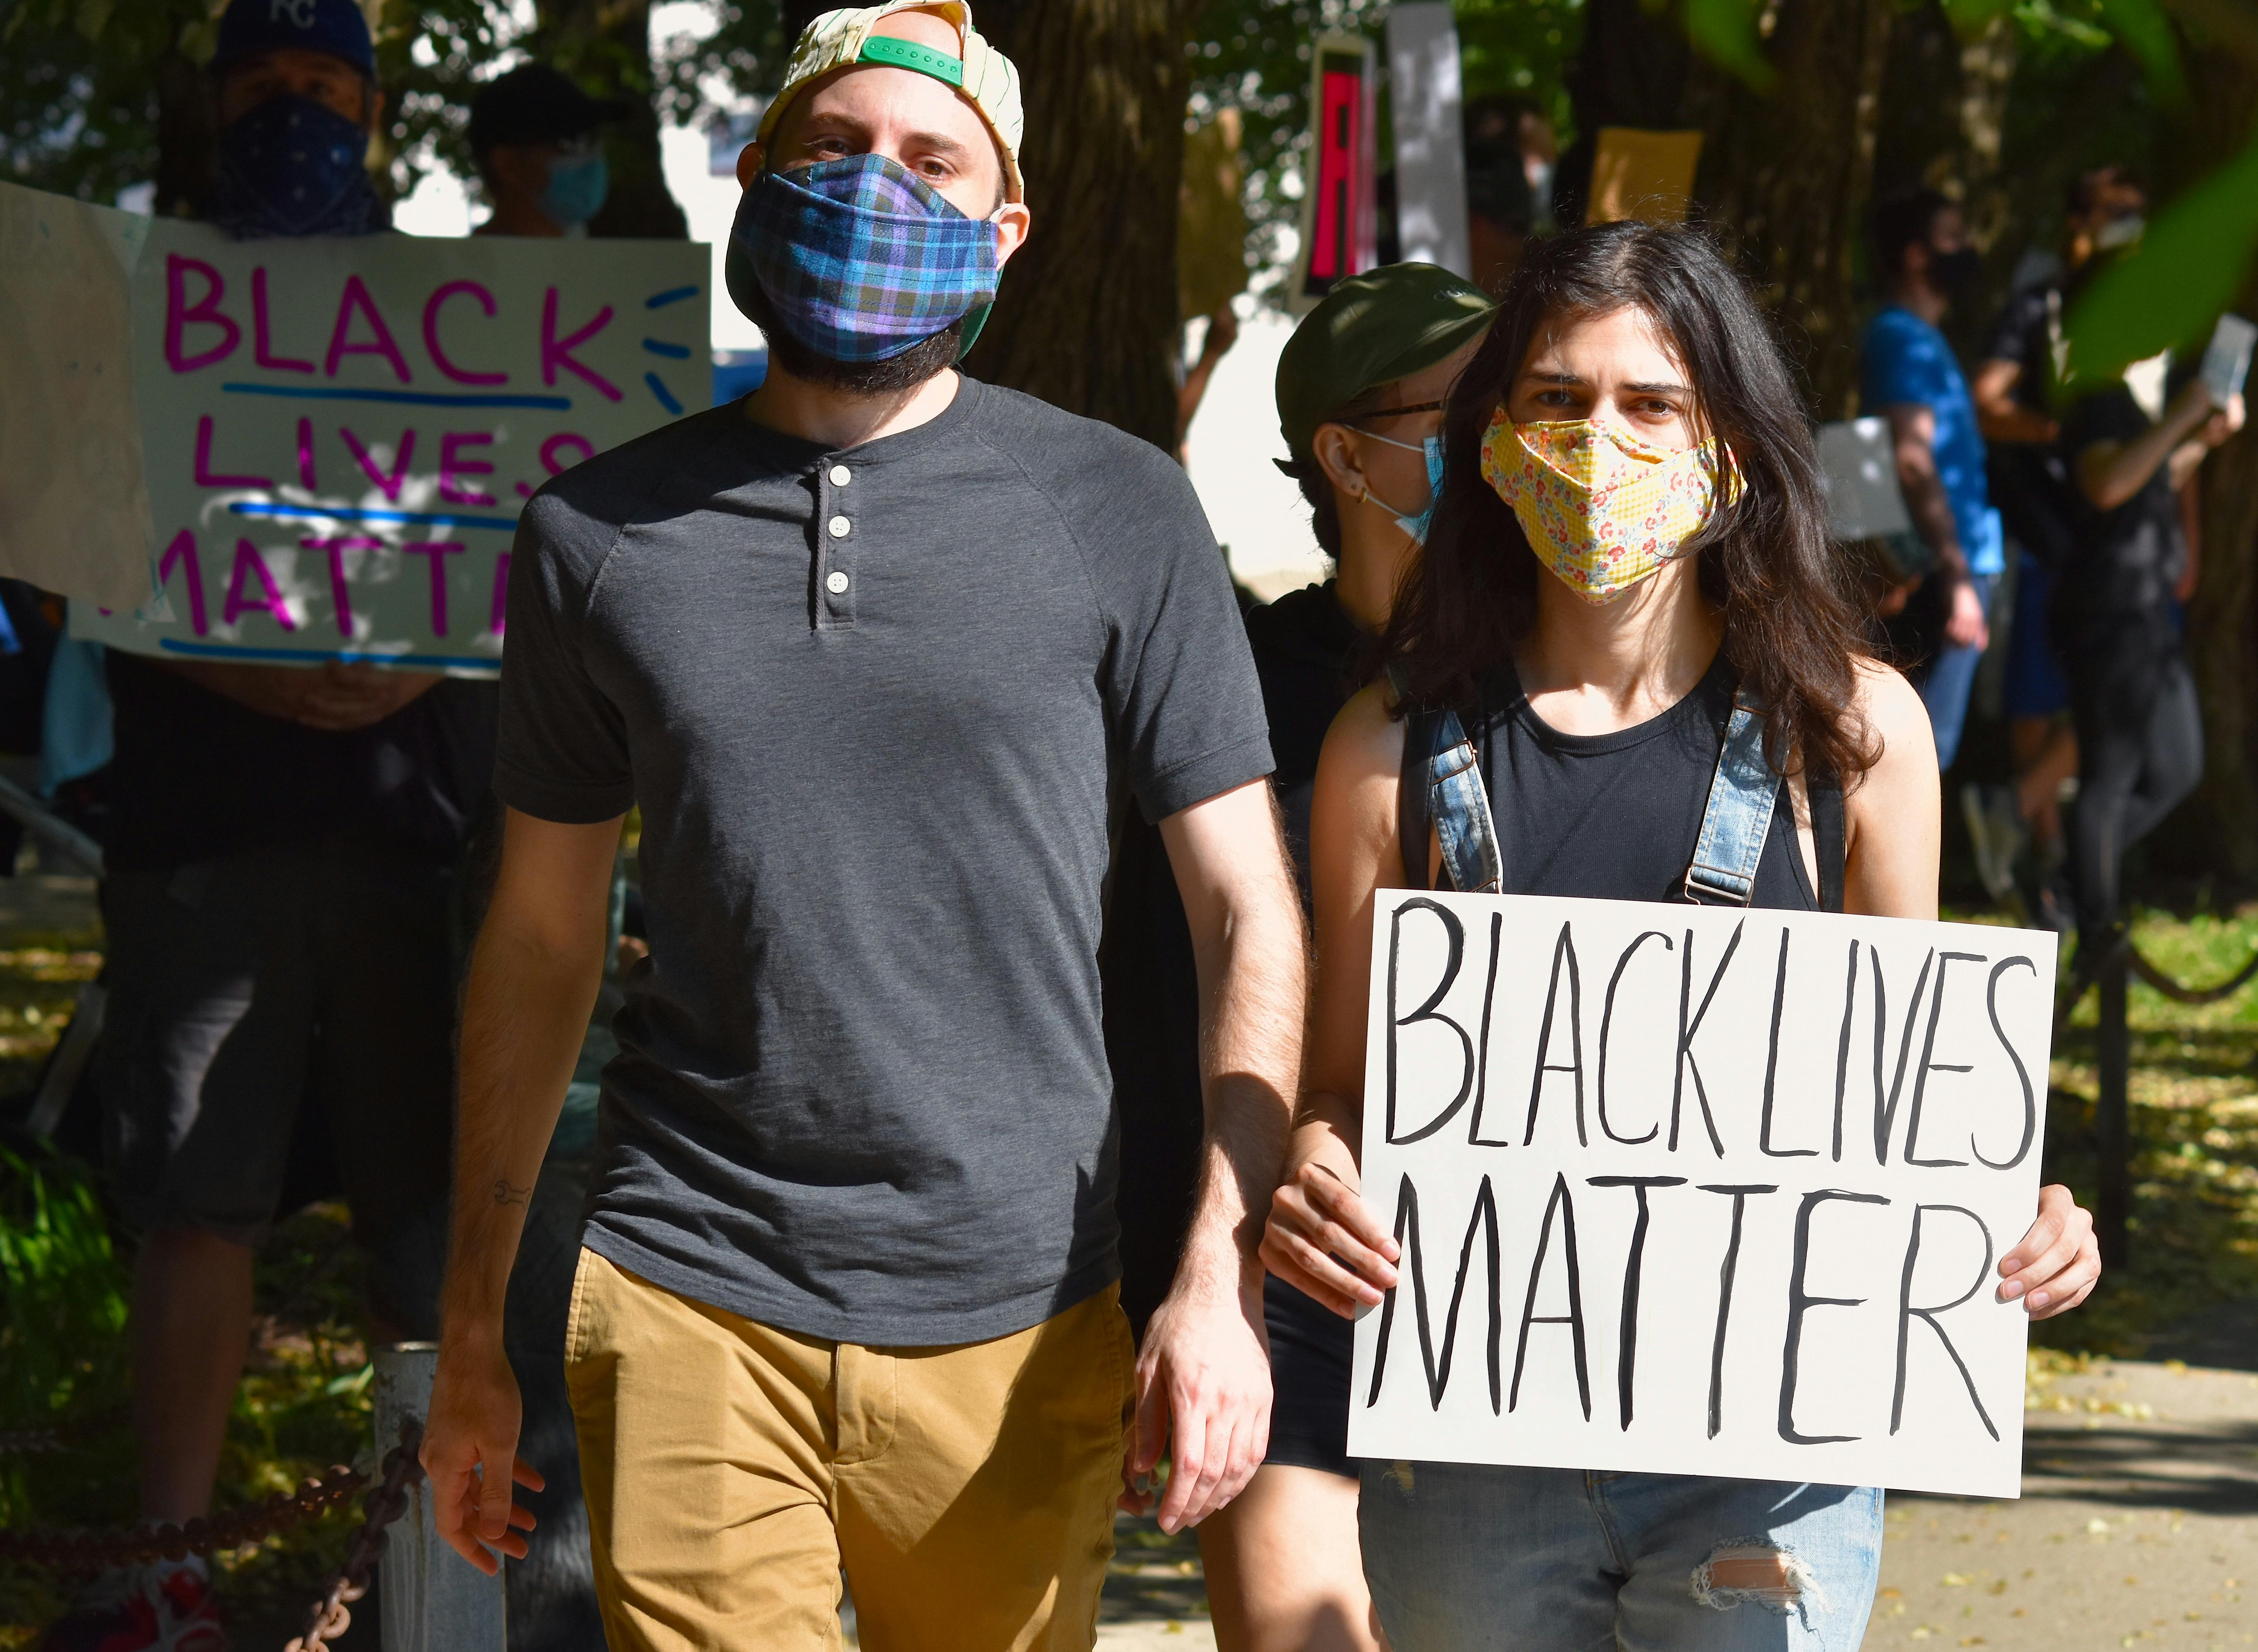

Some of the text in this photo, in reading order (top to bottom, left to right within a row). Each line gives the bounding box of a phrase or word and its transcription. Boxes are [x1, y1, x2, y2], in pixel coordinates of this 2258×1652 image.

[166, 253, 623, 402] BLACK
[1385, 896, 2037, 1170] BLACK LIVES
[1366, 1171, 2001, 1445] MATTER
